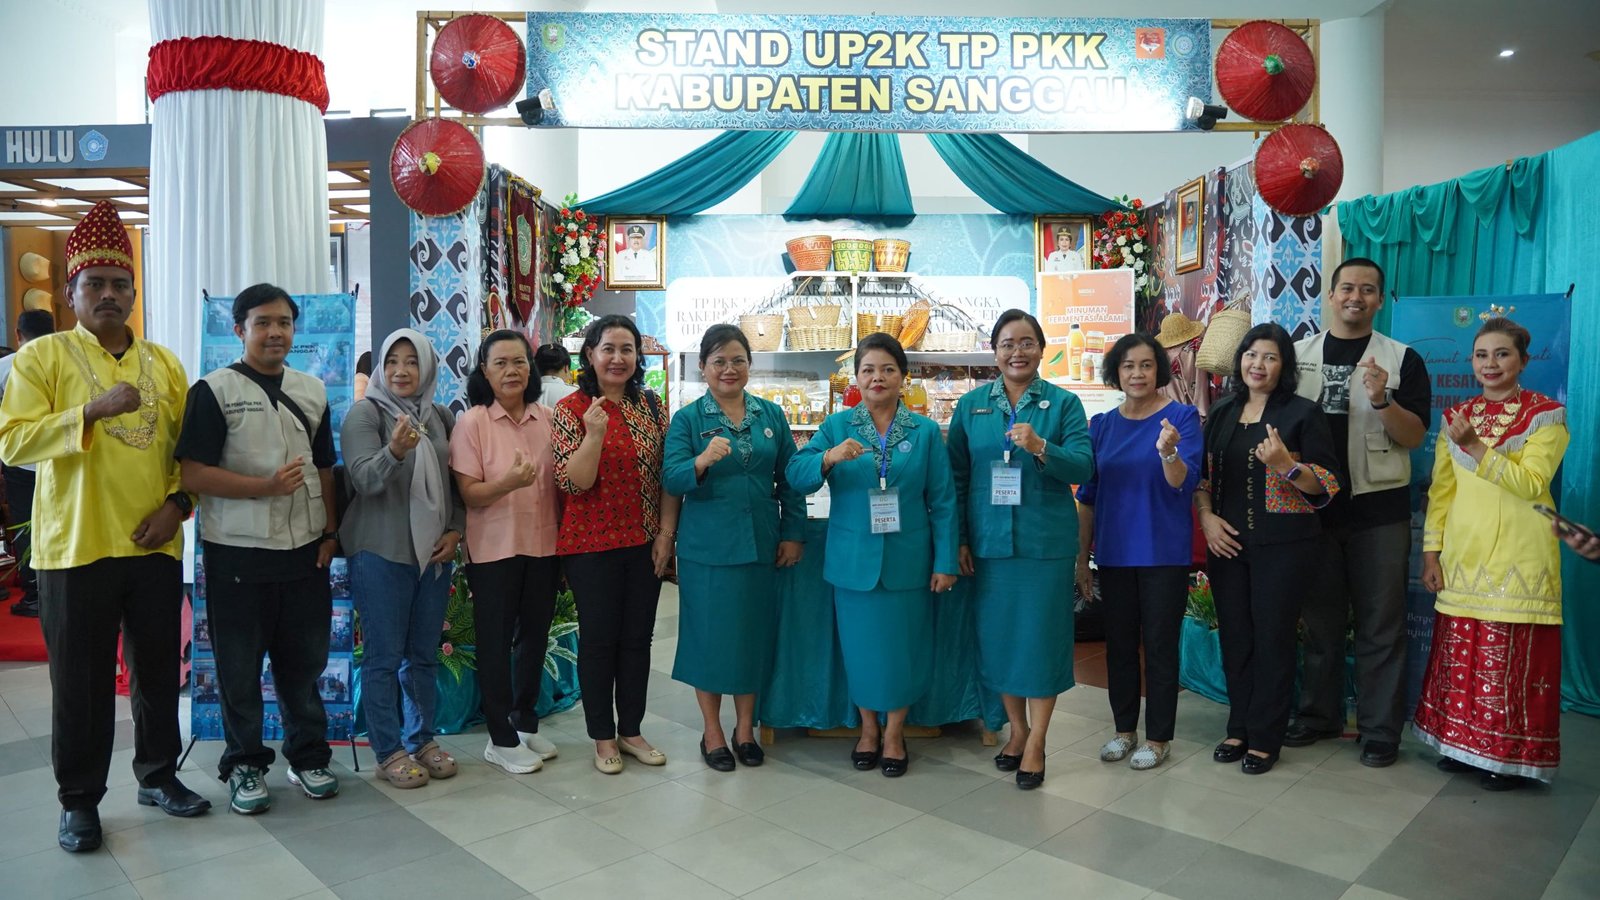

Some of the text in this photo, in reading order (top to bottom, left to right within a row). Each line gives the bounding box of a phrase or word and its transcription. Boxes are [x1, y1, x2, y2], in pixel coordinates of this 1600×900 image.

[637, 28, 1107, 70] STAND UP2K TP PKK
[615, 73, 1127, 114] KABUPATEN SANGGAU
[6, 130, 74, 163] HULU
[1066, 306, 1107, 315] MINUMAN
